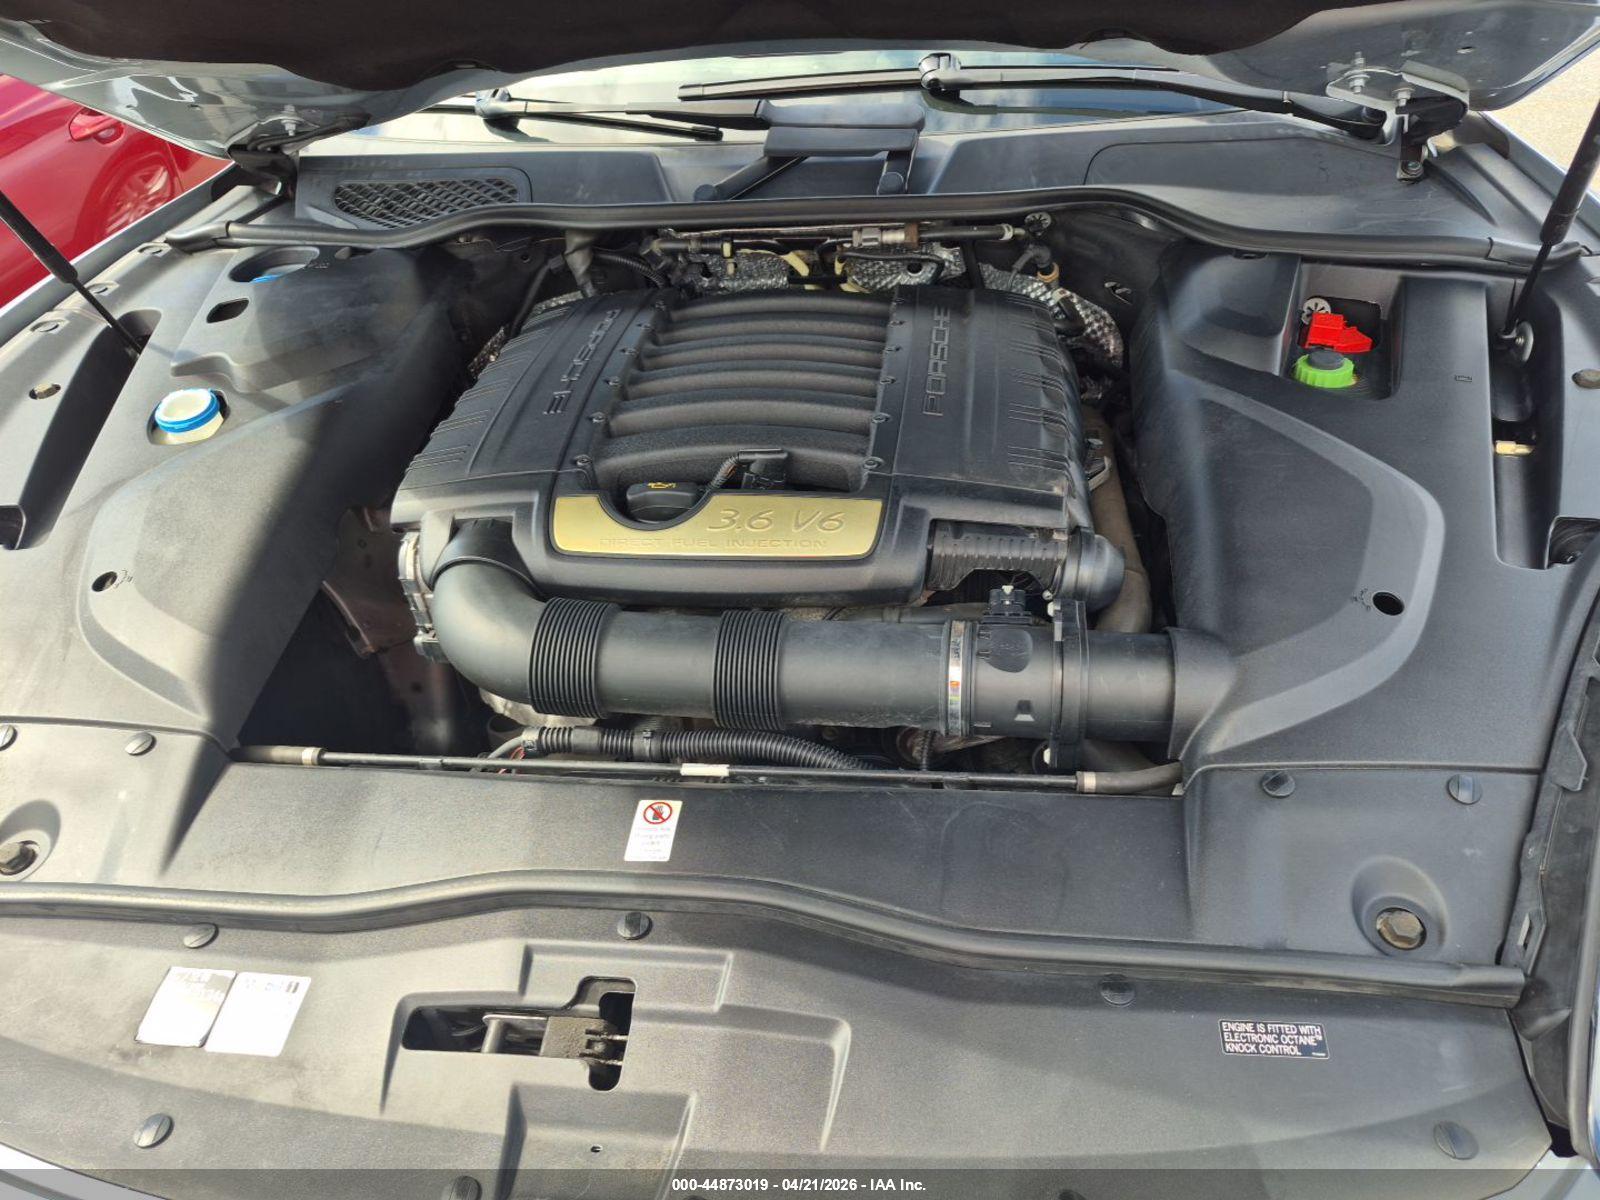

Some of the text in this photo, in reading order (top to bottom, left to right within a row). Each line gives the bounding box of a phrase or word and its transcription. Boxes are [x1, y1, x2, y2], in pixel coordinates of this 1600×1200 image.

[923, 306, 951, 417] PORSCHE
[706, 508, 846, 532] 3.6 V6
[674, 538, 718, 549] FUEL
[726, 538, 828, 549] INJECTION
[1222, 1022, 1322, 1035] ENGINE IS FITTED WITH
[1224, 1033, 1281, 1043] ELECTRONIC
[1226, 1043, 1258, 1053] KNOCK
[1259, 1045, 1302, 1055] CONTROL
